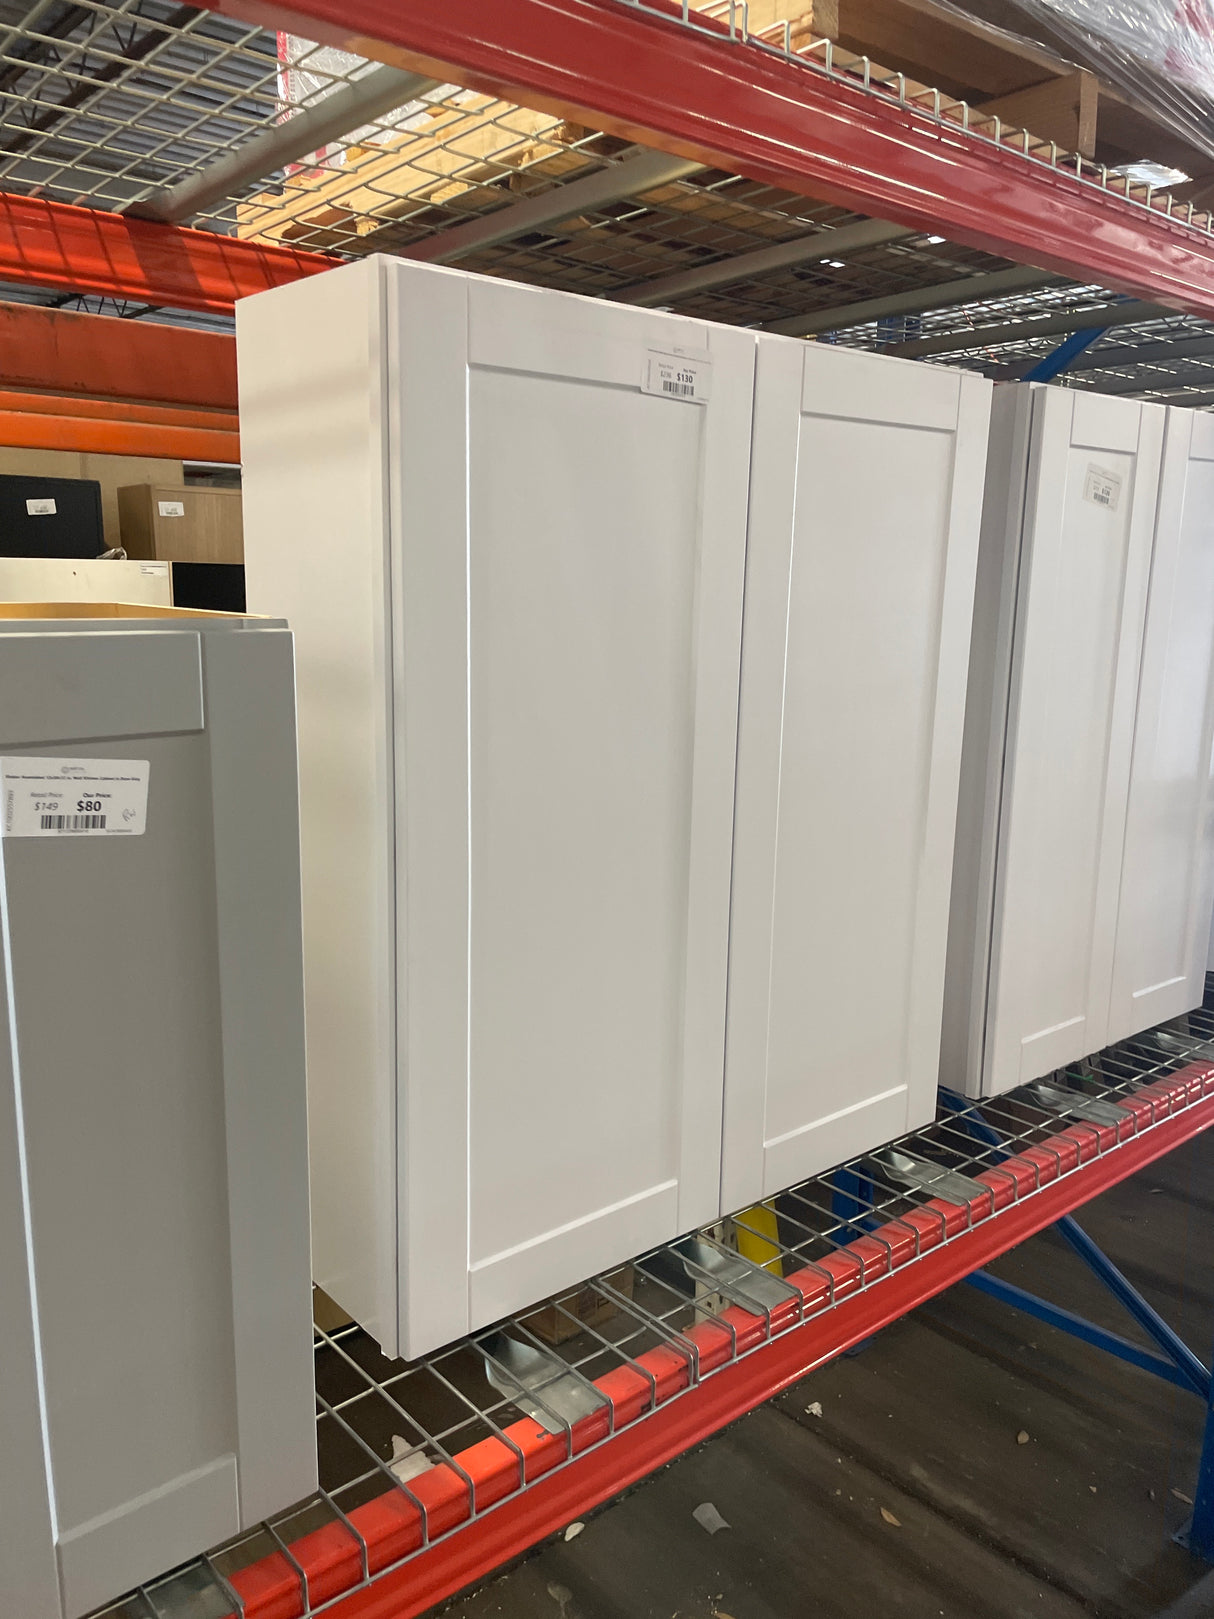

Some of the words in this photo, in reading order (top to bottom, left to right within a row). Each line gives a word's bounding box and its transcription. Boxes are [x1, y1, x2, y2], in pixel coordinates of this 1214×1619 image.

[677, 372, 693, 384] $130
[34, 801, 59, 811] $149
[77, 799, 102, 812] $80
